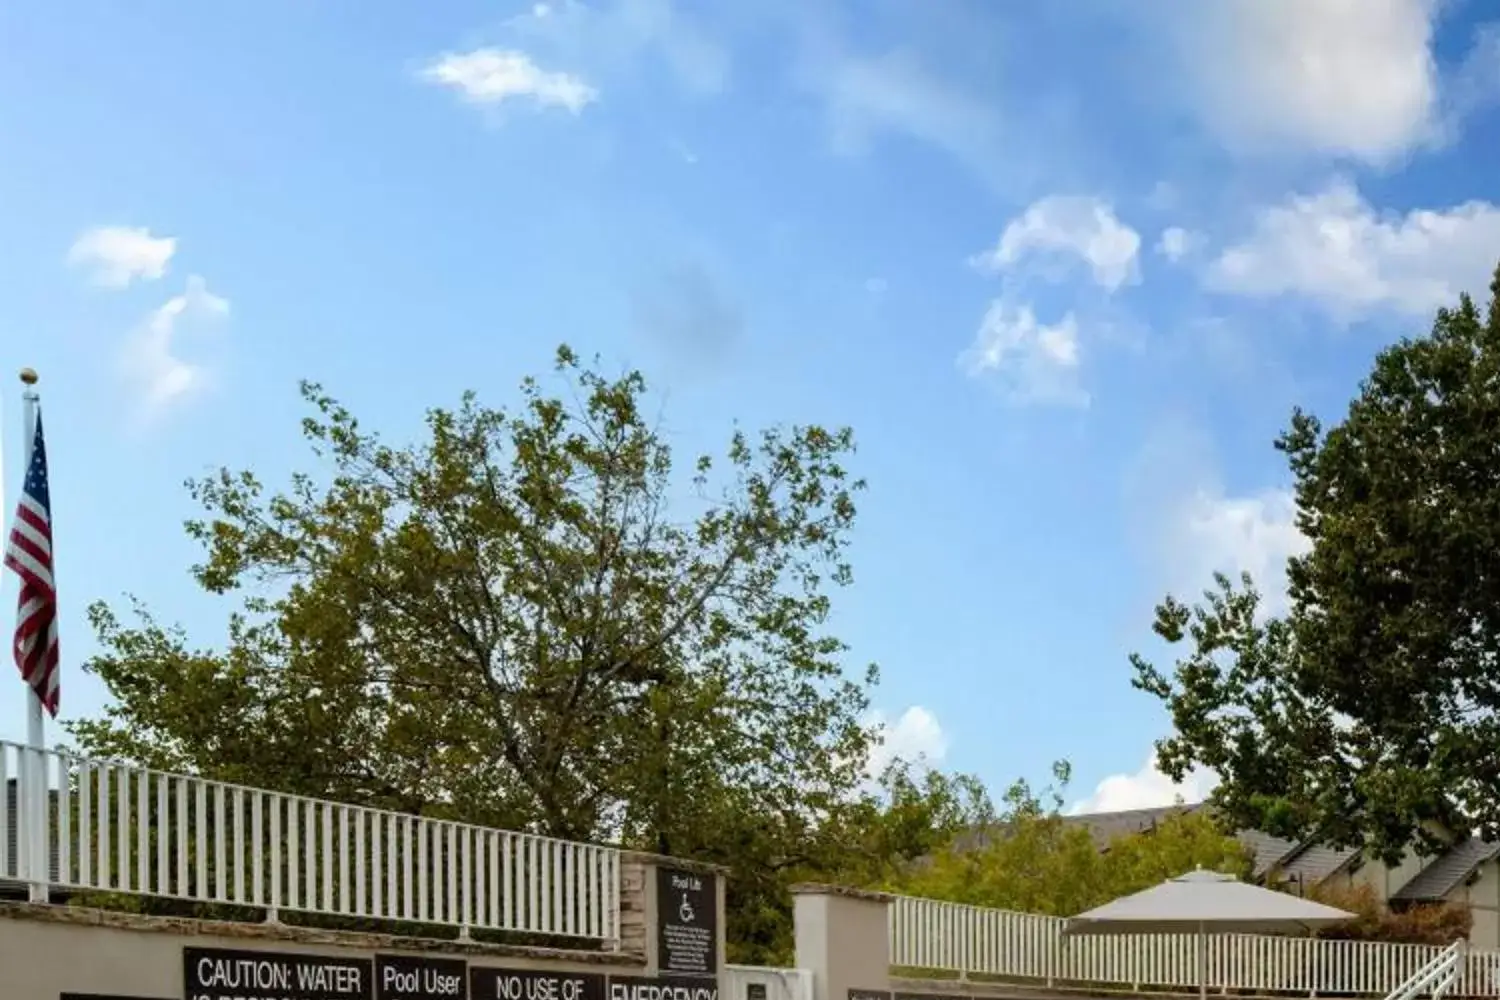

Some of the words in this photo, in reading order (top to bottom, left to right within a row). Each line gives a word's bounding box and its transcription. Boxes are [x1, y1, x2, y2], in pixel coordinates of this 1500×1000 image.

[198, 958, 291, 990] CAUTION:
[297, 965, 361, 993] WATER
[383, 966, 419, 992] Pool
[425, 969, 460, 994] User
[497, 976, 520, 999] NO
[527, 978, 557, 1000] USE
[563, 980, 584, 1000] OF
